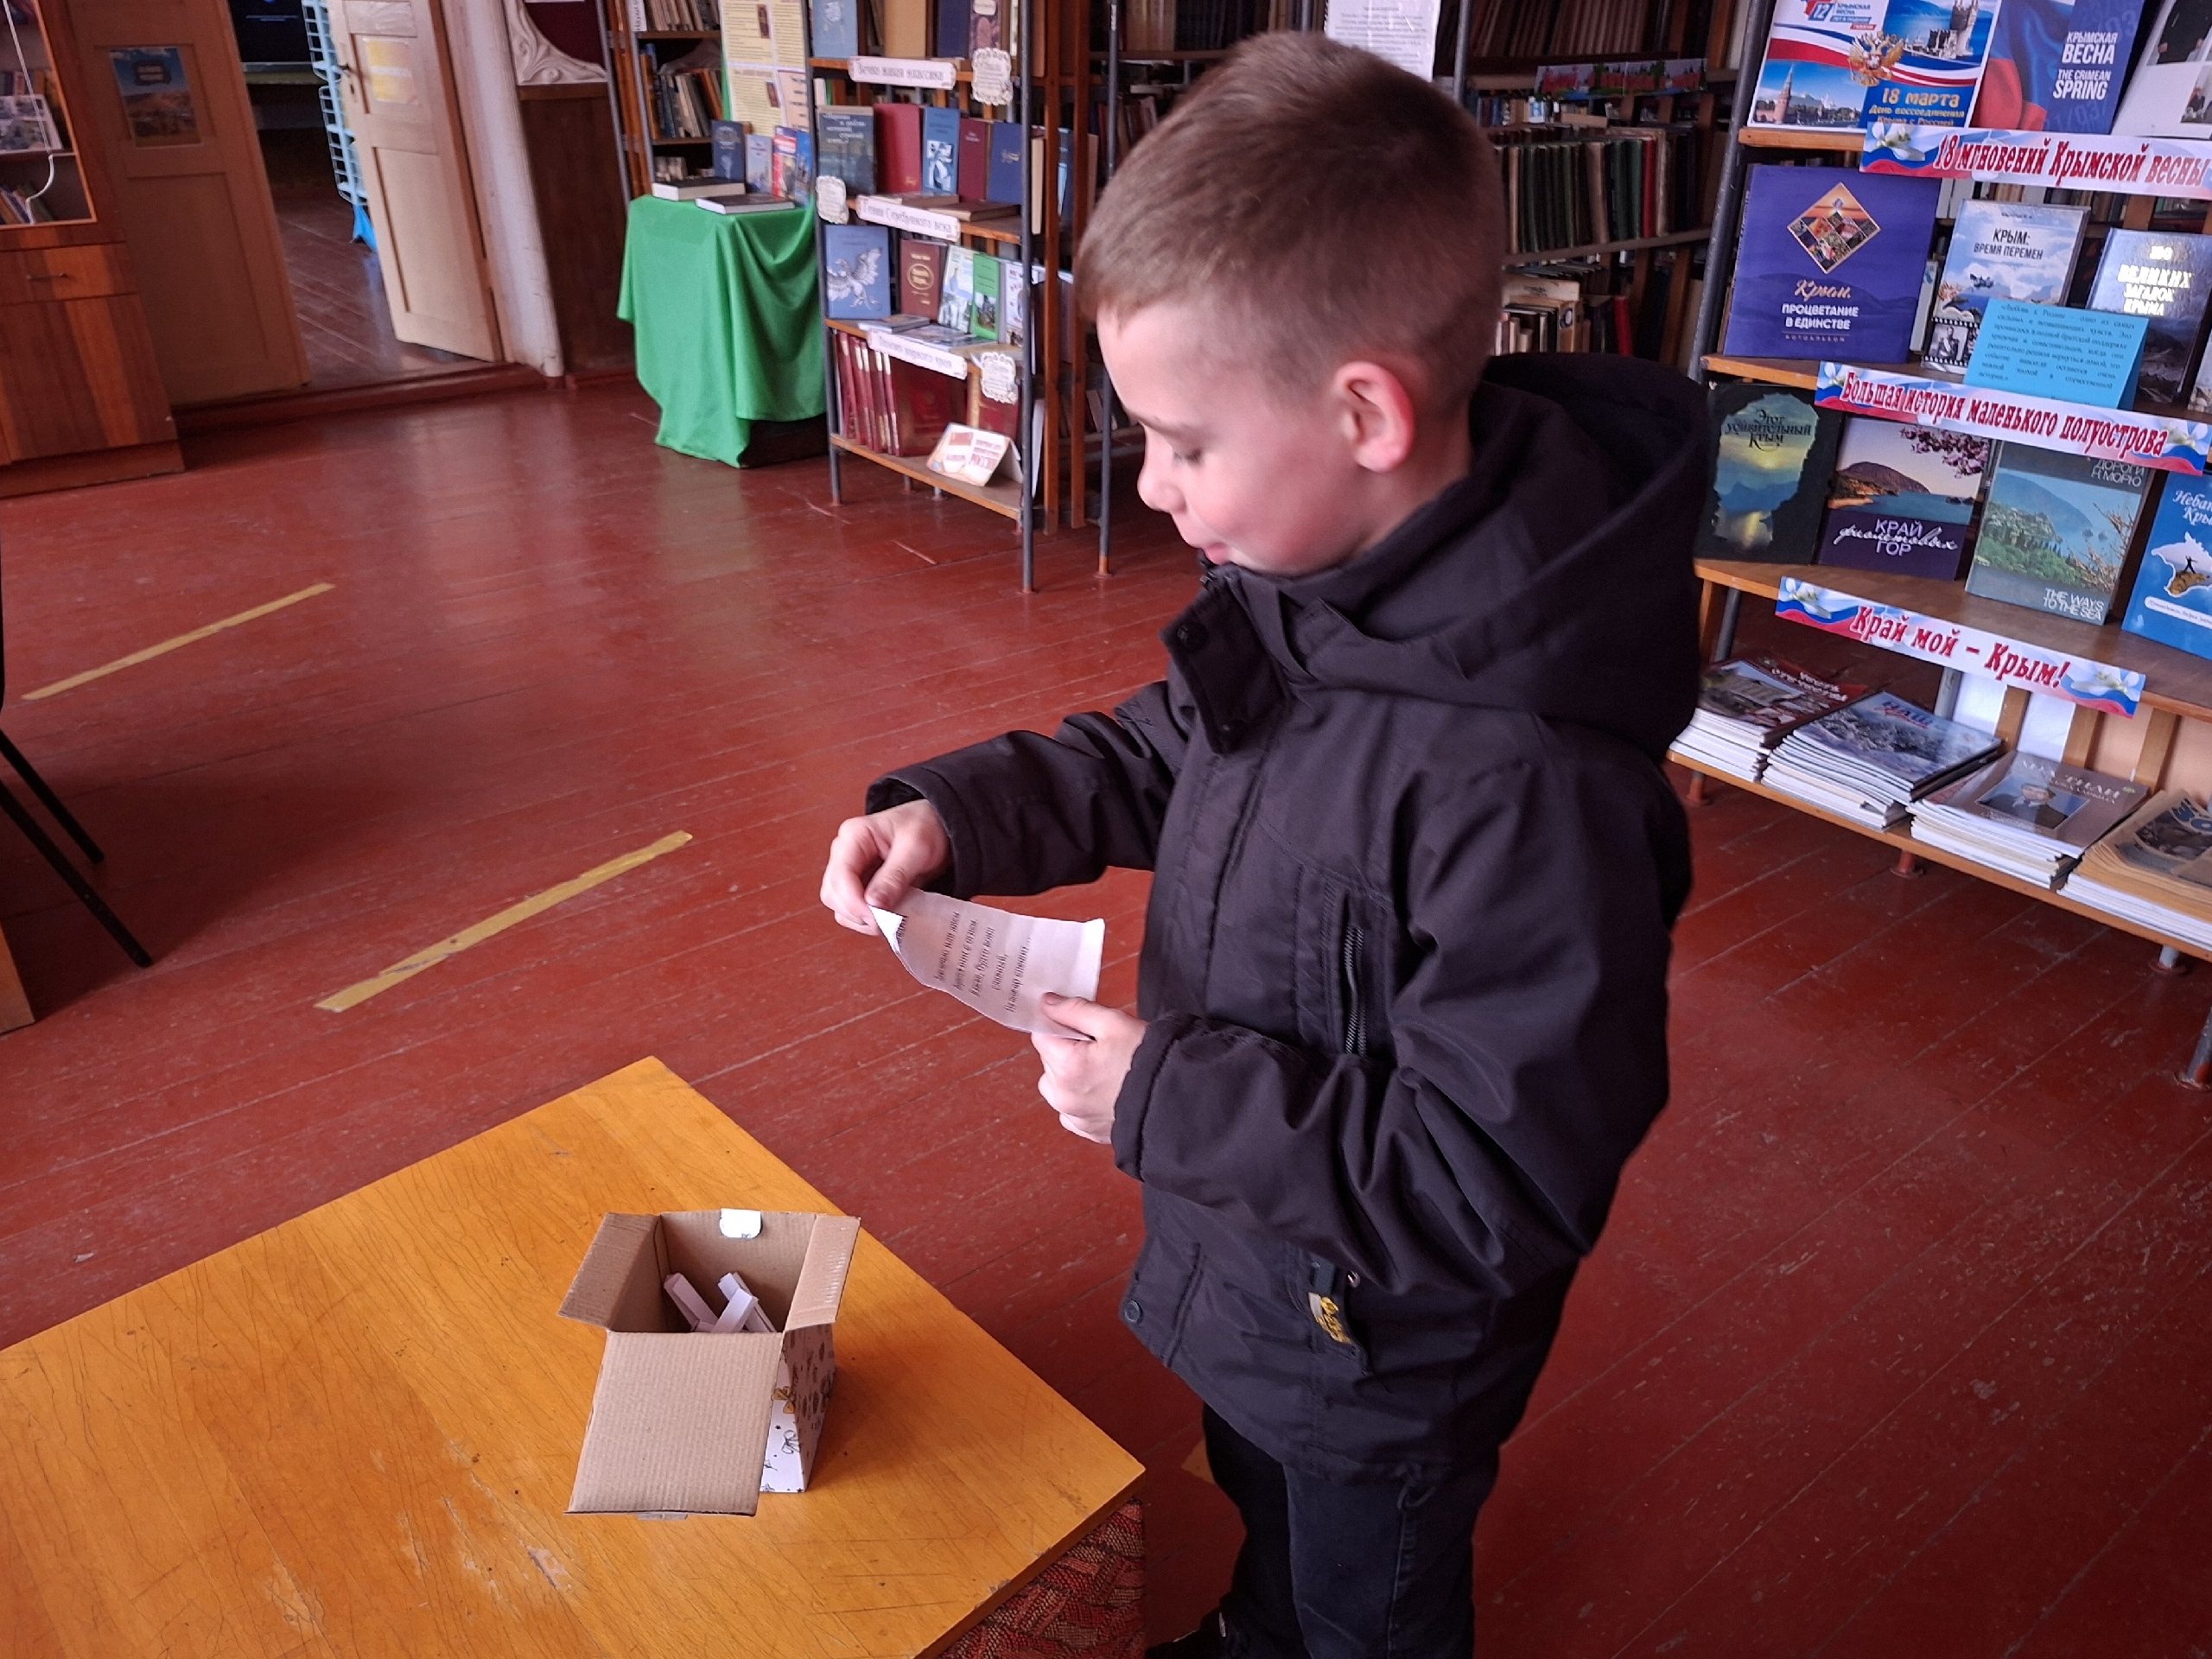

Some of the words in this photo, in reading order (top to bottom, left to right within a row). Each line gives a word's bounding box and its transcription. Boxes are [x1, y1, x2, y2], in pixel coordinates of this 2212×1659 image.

[2067, 31, 2118, 43] КРЫМСКАЯ
[2062, 44, 2115, 64] ВЕСНА
[2058, 68, 2073, 80] THE
[2075, 69, 2111, 82] CRIMEAN
[1883, 87, 1900, 104] 18
[2053, 80, 2108, 100] SPRING
[1936, 134, 1956, 168] 18
[1959, 137, 2051, 175] мгновений
[2049, 140, 2149, 187] Крымской
[2145, 154, 2210, 187] весны
[1993, 228, 2031, 245] КРЫМ:
[1974, 243, 2002, 255] ВРЕМЯ
[2004, 246, 2043, 259] ПЕРЕМЕН
[1782, 303, 1859, 317] ПРОЦВЕТАНИЕ
[1785, 317, 1793, 328] В
[1795, 317, 1851, 330] ЕДИНСТВЕ
[1841, 372, 1904, 408] Большая
[1903, 388, 1966, 424] история
[1967, 398, 2058, 436] маленького
[2059, 416, 2168, 459] полуострова
[2103, 470, 2141, 486] МОРЮ
[1875, 518, 1923, 537] КРАЙ
[1876, 541, 1911, 556] ГОР
[2045, 588, 2069, 601] THE
[2071, 594, 2104, 611] WAYS
[2044, 596, 2056, 609] TO
[2058, 601, 2078, 616] THE
[2080, 607, 2101, 621] SEA
[1852, 607, 1909, 640] Край
[1911, 628, 1960, 658] мой
[1985, 642, 2070, 689] Крым!
